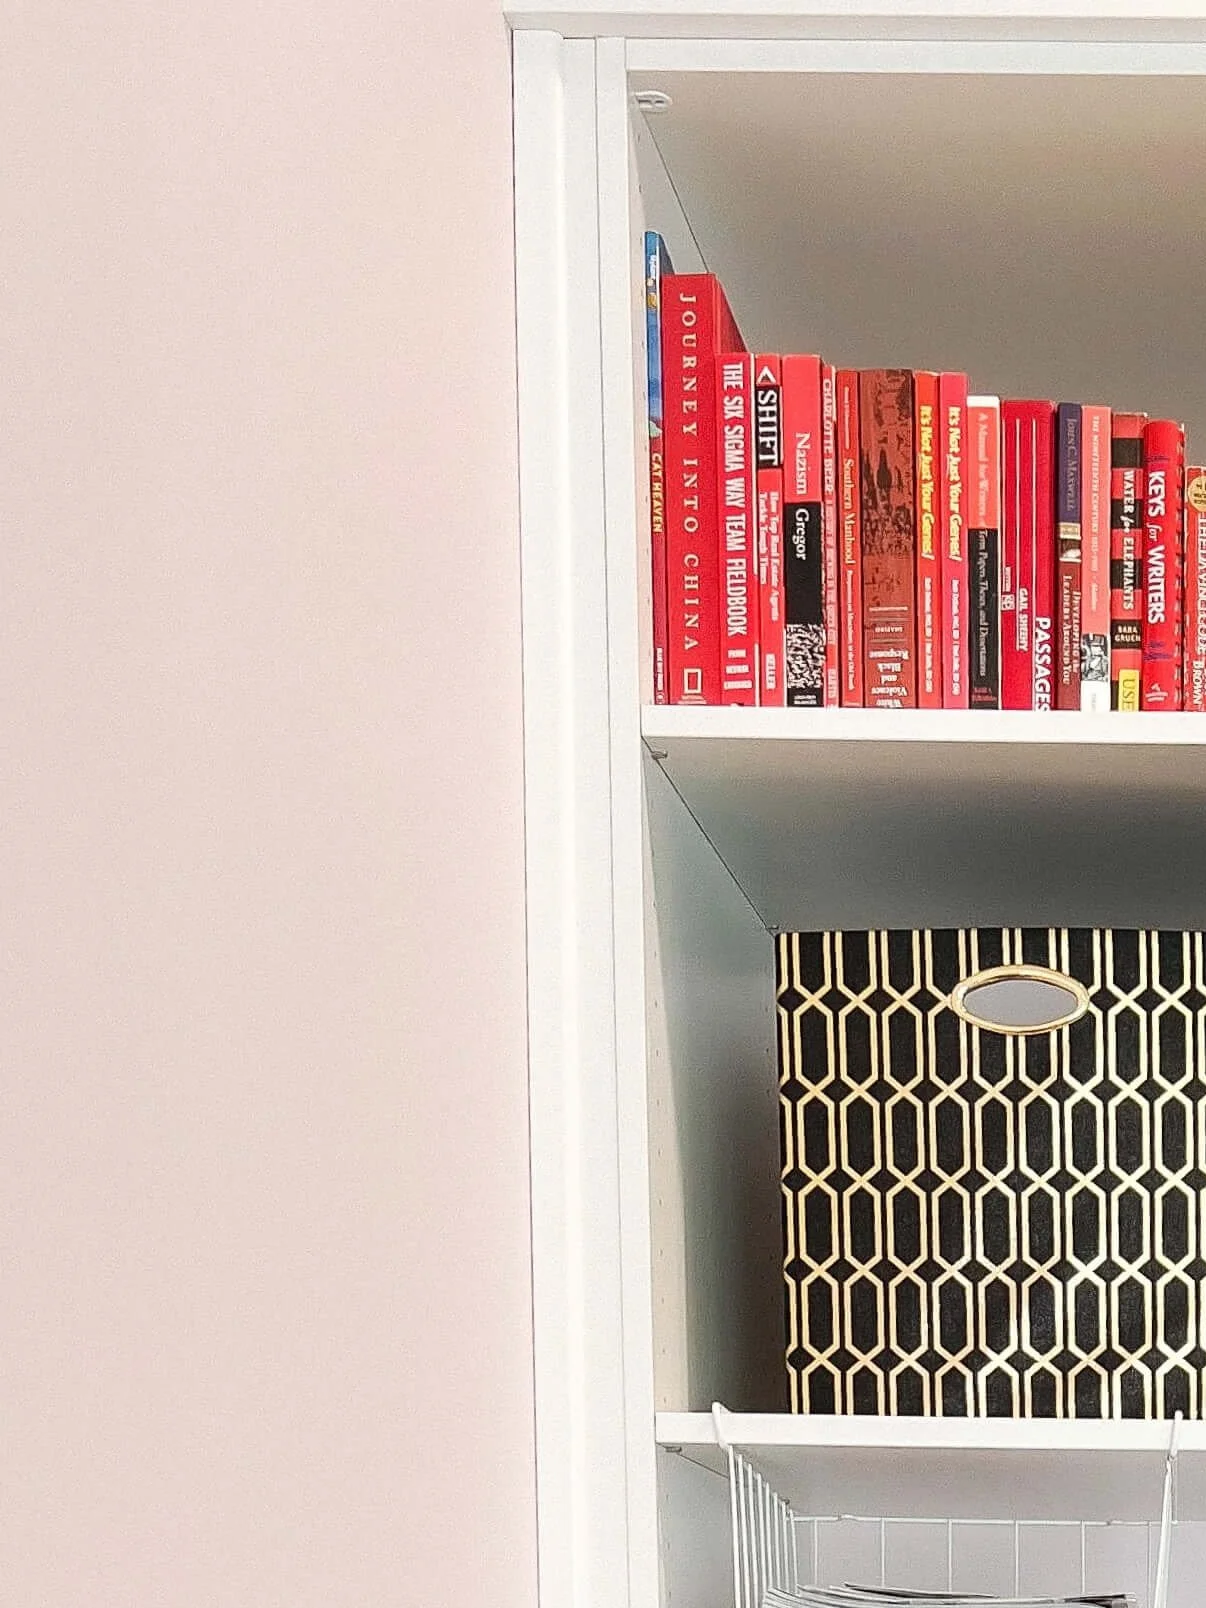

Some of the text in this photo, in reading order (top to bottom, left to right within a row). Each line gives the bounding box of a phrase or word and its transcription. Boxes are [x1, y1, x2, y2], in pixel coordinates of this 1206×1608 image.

[724, 362, 744, 391] THE
[724, 395, 745, 420] SIX
[724, 424, 746, 472] SIGMA
[758, 389, 779, 466] SHIFT
[823, 379, 833, 496] CHARLOTTE BEER
[652, 453, 665, 533] CAT HEAVEN
[680, 292, 700, 650] JOURNEY INTO CHINA
[725, 477, 746, 508] WAY
[795, 432, 811, 495] Nazism
[844, 457, 855, 509] Southern
[918, 405, 935, 560] It's Not Just Your Genes!
[947, 407, 963, 562] It's Not Just Your Genes!
[1066, 418, 1077, 511] JOHN MAXWELL
[726, 514, 747, 552] TEAM
[792, 507, 810, 560] Gregor
[845, 512, 857, 565] Manhood
[1120, 470, 1135, 610] WATER for ELEPHANTS
[1146, 471, 1166, 624] KEYS for WRITERS
[727, 558, 748, 637] FIELDBOOK
[770, 557, 780, 621] Estate Agents
[1018, 588, 1029, 652] GAIL SHEEHY
[1062, 575, 1073, 686] LEADERS AROUND YOU
[1071, 591, 1081, 656] DEVELOPING
[1034, 616, 1052, 712] PASSAGES
[1192, 660, 1205, 704] BROWN
